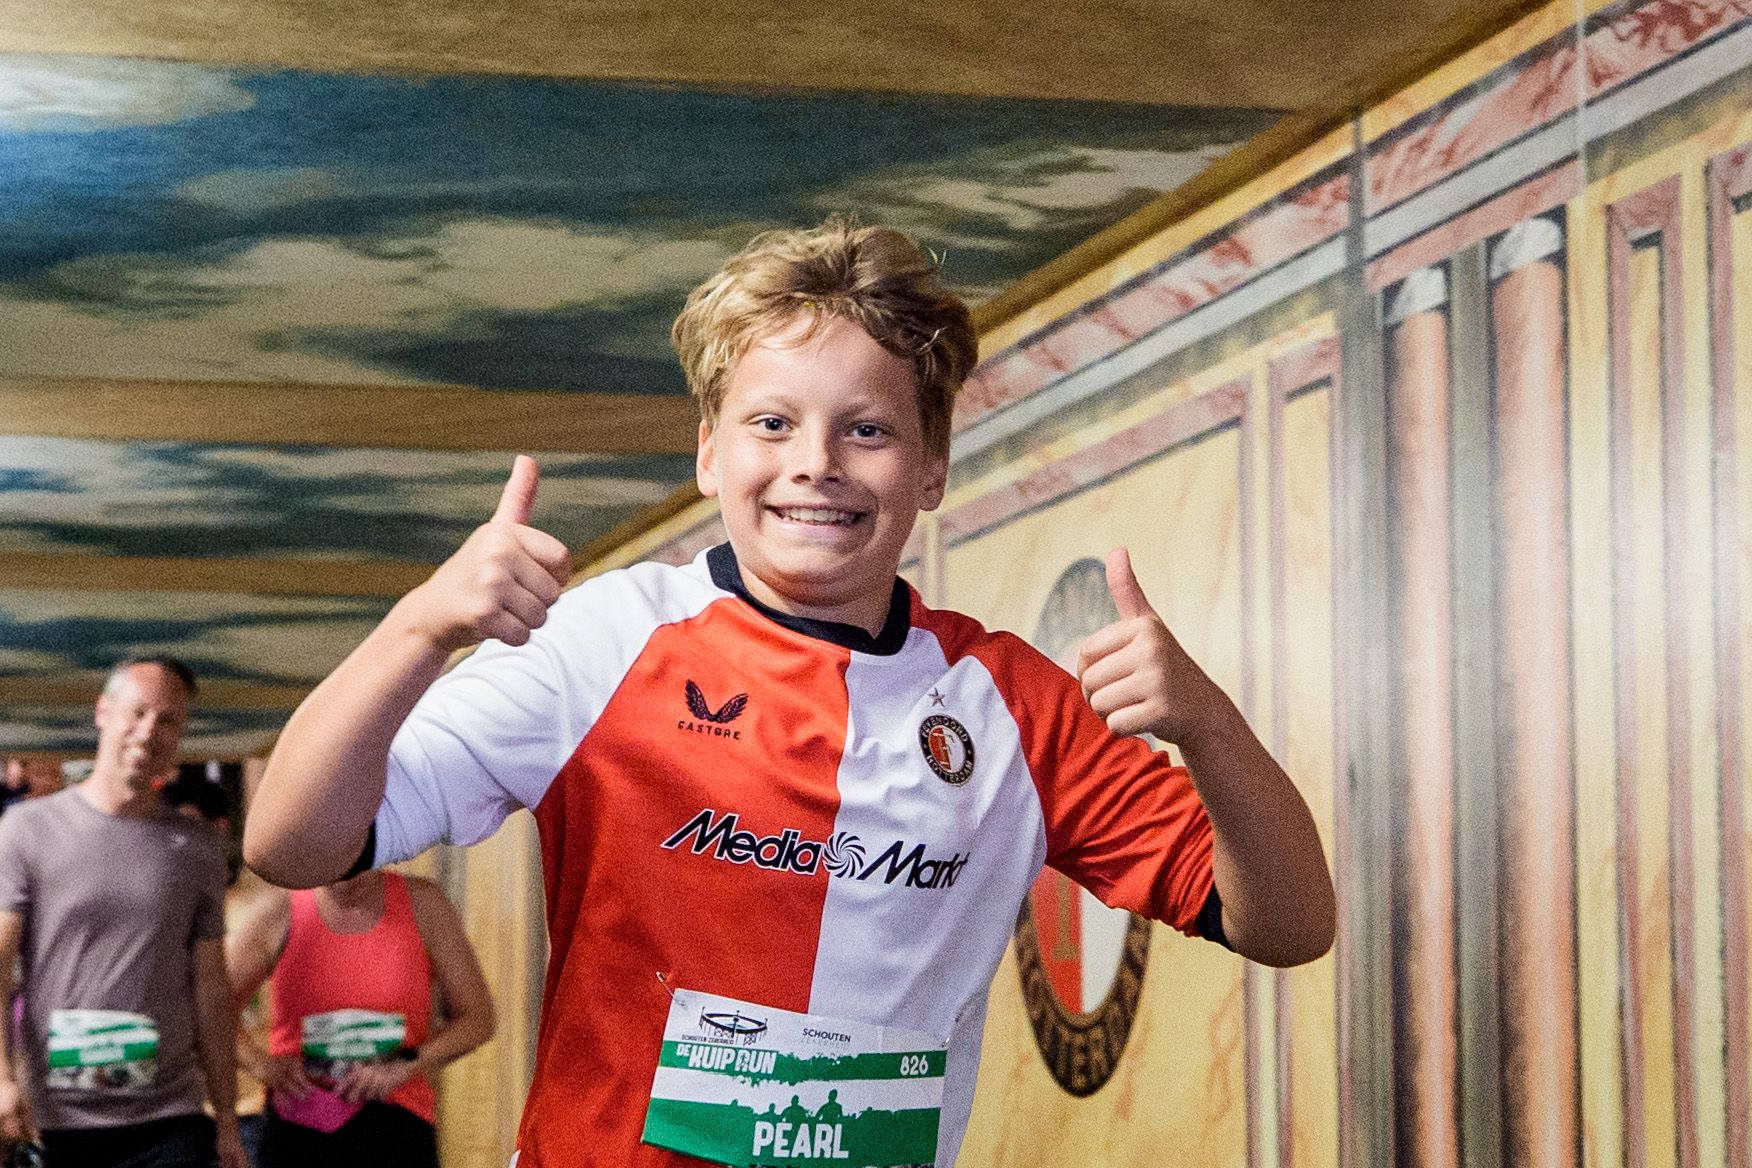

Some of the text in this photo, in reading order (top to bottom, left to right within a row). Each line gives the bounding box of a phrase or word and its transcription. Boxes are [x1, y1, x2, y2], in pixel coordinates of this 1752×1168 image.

[677, 720, 741, 740] CASTORE
[921, 716, 969, 742] FEYENOORD
[926, 755, 973, 783] ROTTERDAM
[660, 808, 822, 875] Media
[802, 1028, 851, 1043] SCHOUTEN
[676, 1043, 777, 1075] DE KUIP RUN
[900, 1054, 929, 1076] 826
[752, 1121, 850, 1159] PEARL
